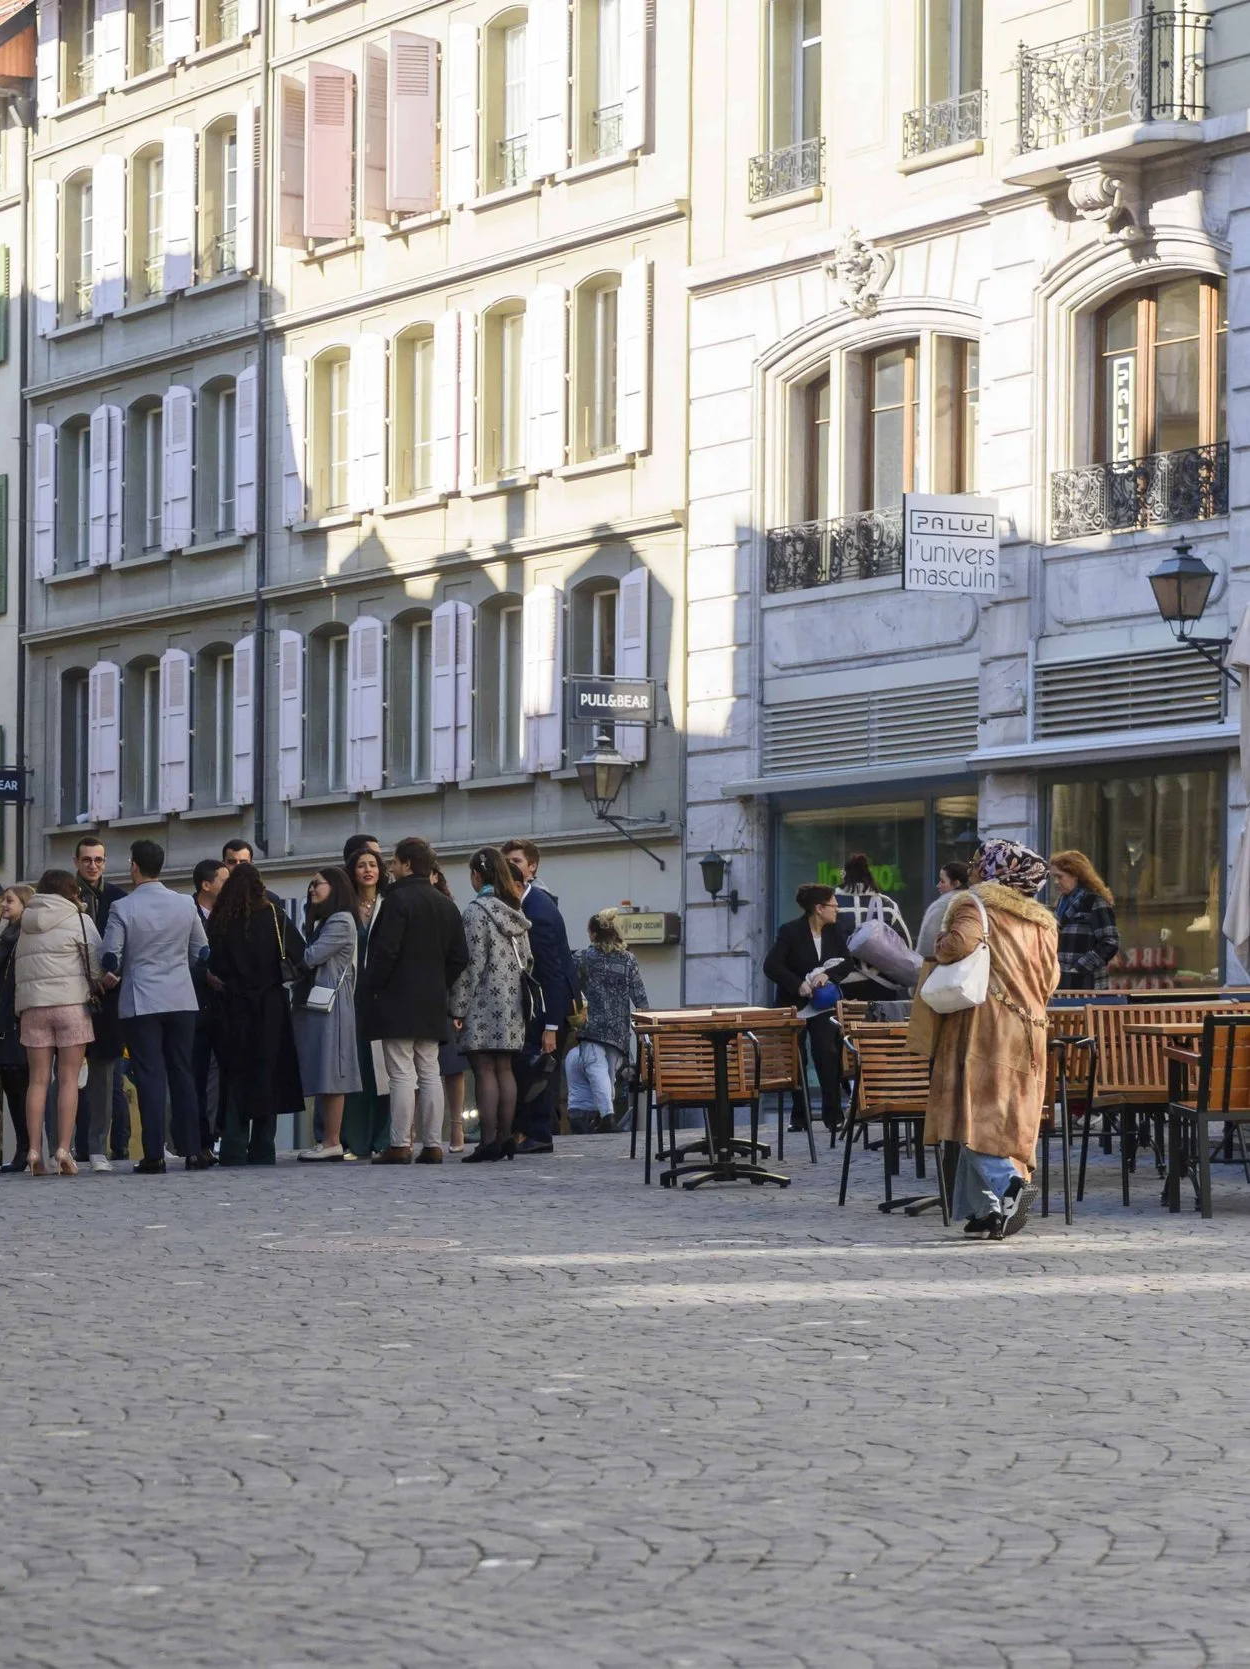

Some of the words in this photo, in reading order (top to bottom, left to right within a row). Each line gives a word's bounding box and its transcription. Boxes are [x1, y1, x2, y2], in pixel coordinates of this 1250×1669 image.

[909, 539, 995, 566] l'univers
[909, 566, 995, 589] masculin
[580, 692, 649, 709] PULL&BEAR
